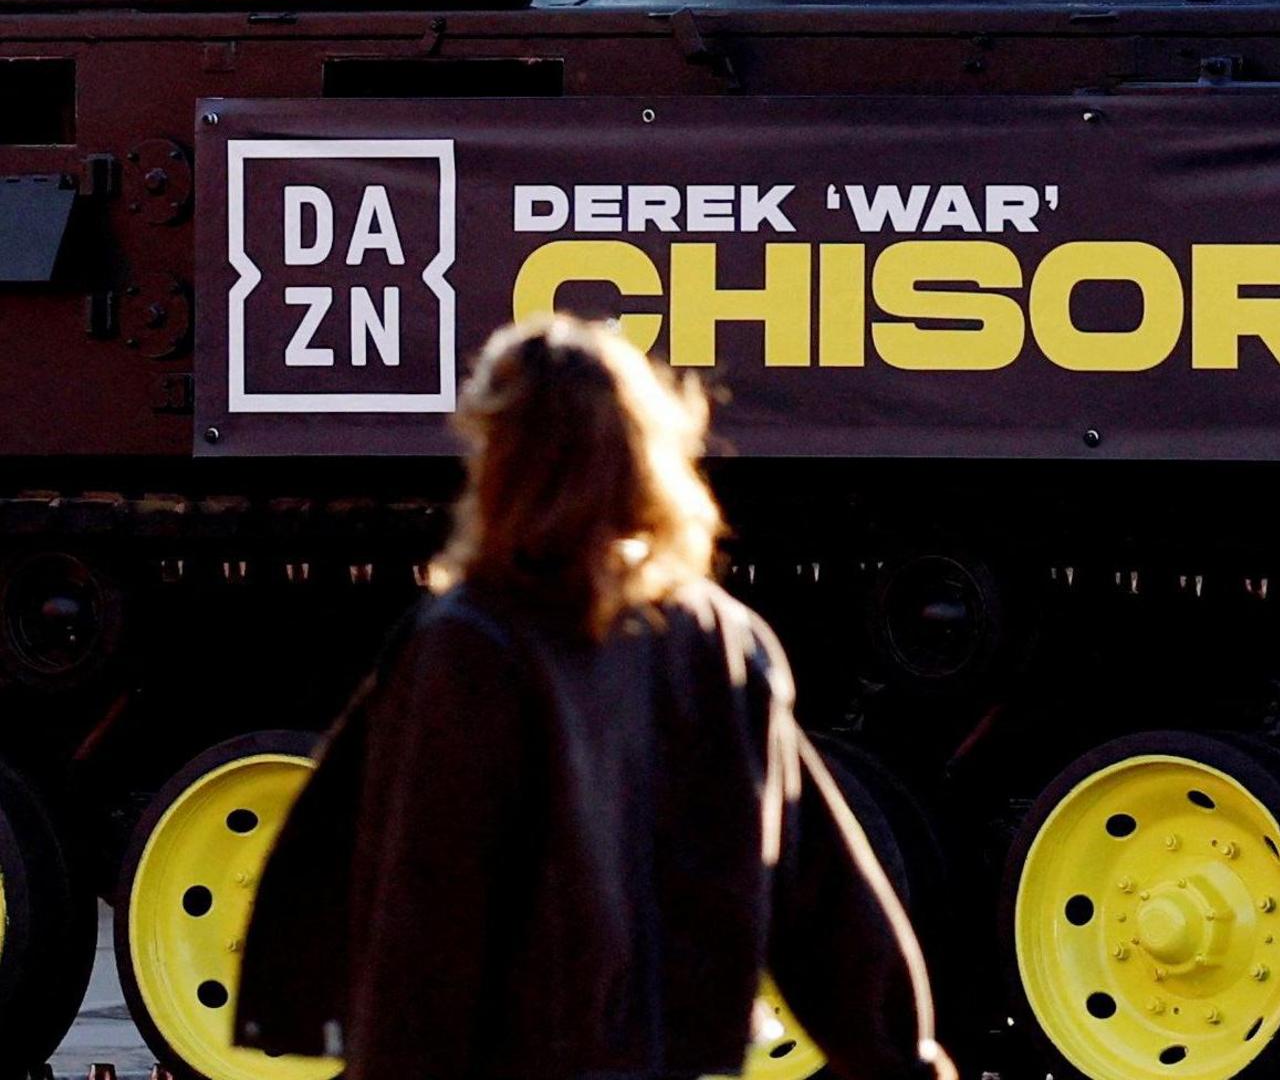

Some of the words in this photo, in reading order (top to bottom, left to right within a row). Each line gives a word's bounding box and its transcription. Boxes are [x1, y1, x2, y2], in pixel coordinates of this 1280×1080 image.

[284, 185, 406, 266] DA
[514, 185, 797, 233] DEREK
[284, 286, 400, 367] ZN
